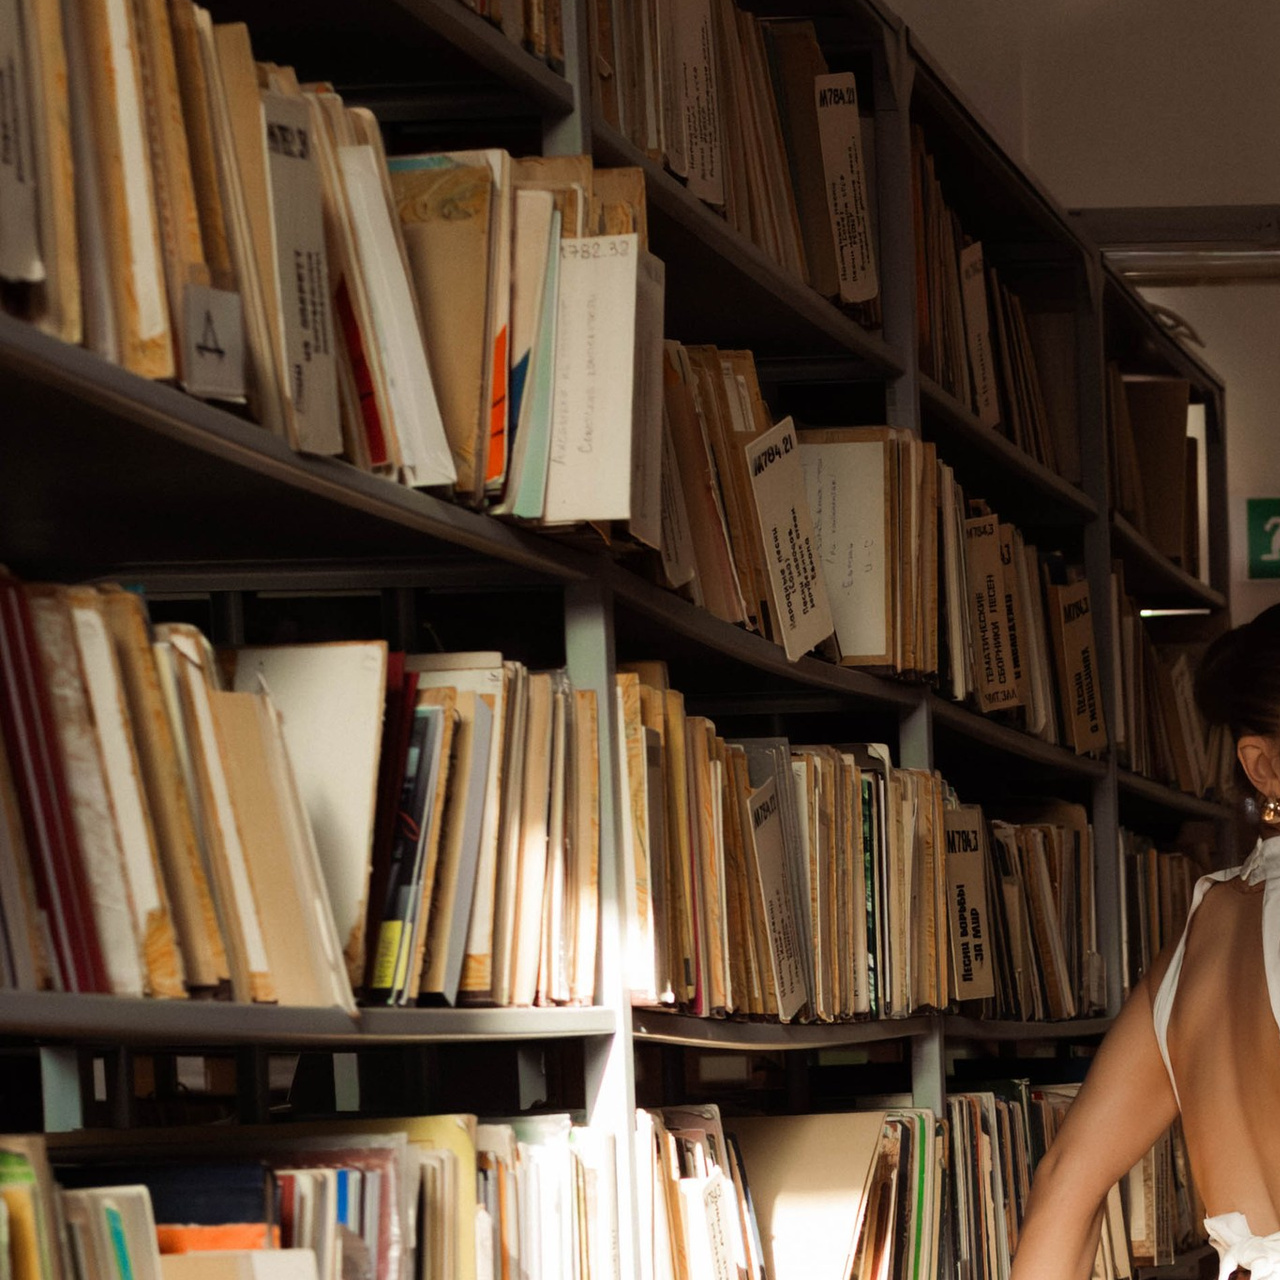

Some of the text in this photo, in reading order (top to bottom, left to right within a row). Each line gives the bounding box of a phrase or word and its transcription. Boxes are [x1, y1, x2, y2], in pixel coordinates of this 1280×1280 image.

[976, 592, 995, 684] ТЕМАТИЧЕСКИЕ
[985, 574, 1007, 684] СБОРНИКИ ПЕСЕН
[947, 830, 979, 854] М784.3
